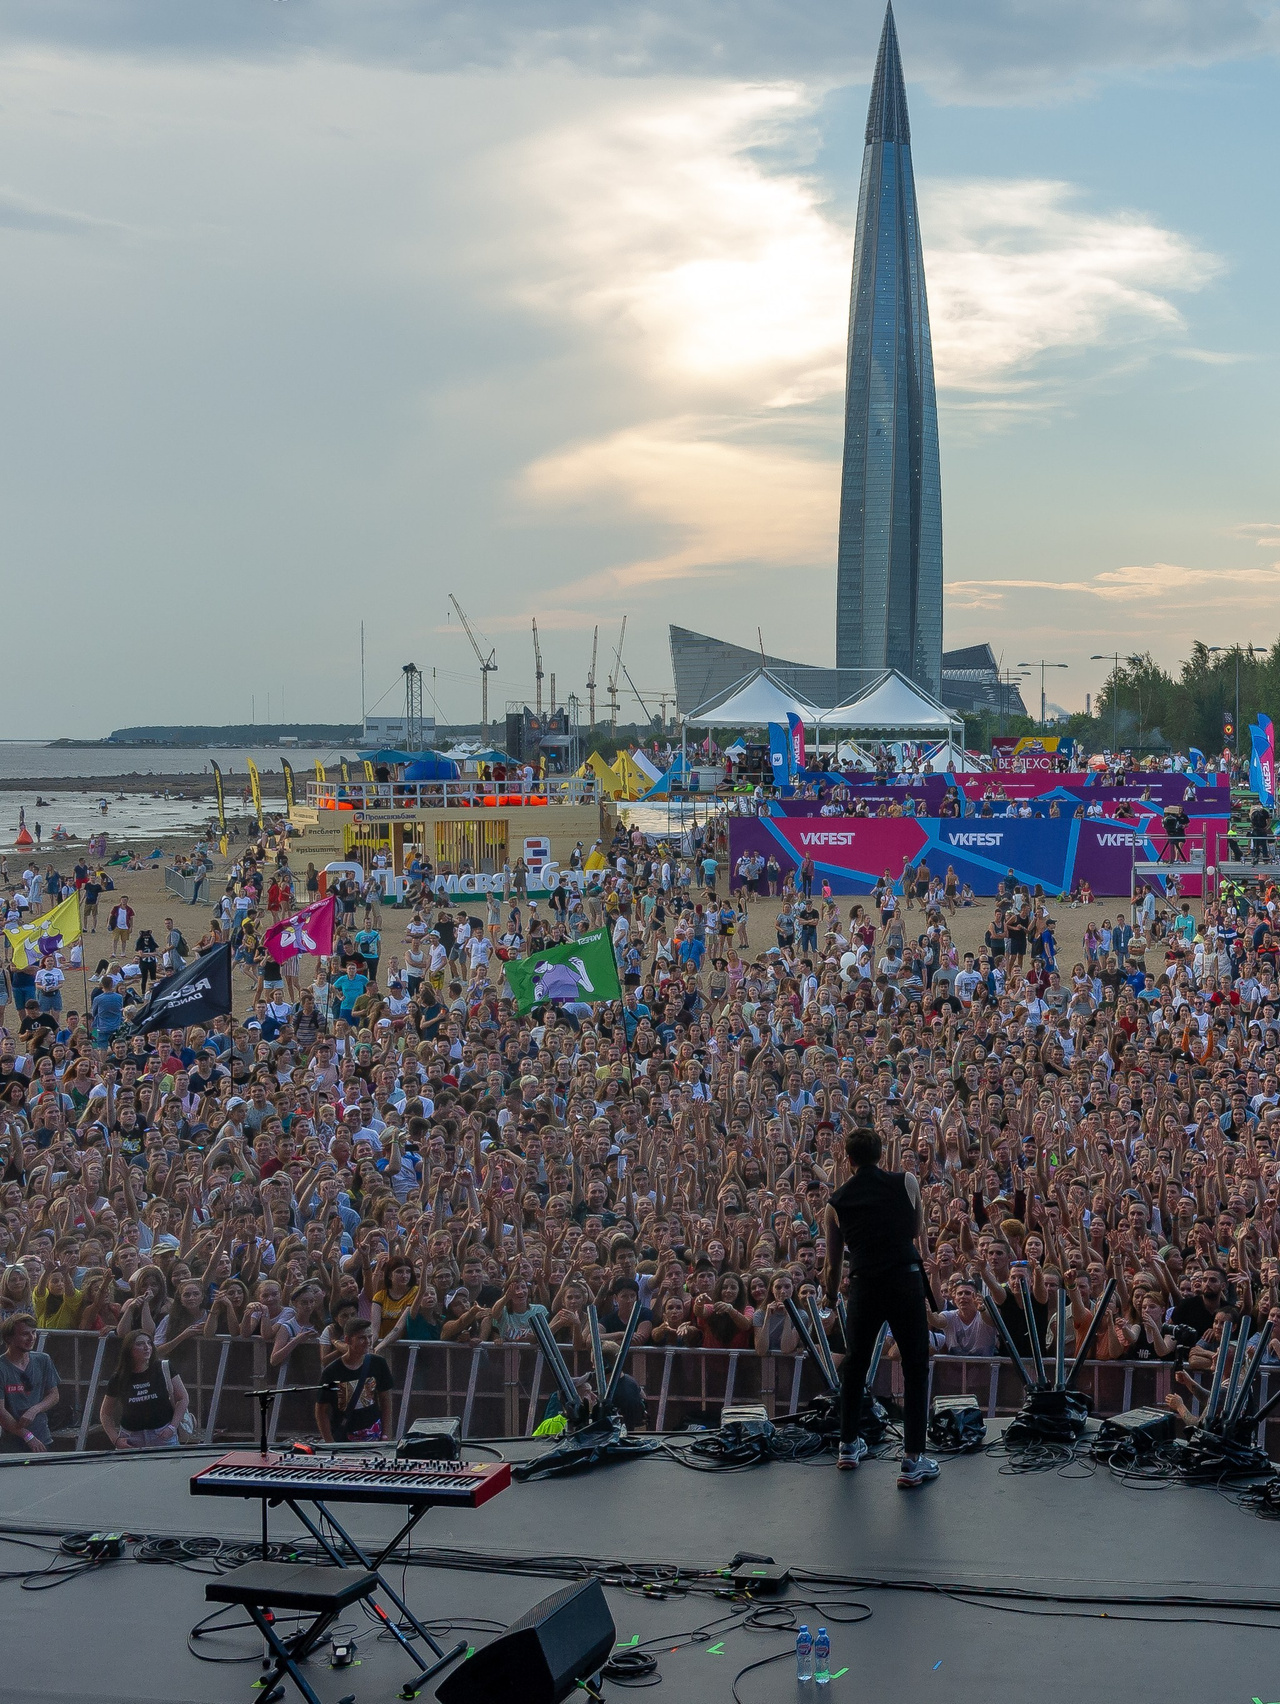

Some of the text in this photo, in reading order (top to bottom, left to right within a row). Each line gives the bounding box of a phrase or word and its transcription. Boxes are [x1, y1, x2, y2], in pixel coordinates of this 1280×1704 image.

[800, 832, 856, 846] VKFEST
[948, 832, 1004, 847] VKFEST
[1096, 832, 1150, 847] VKFEST
